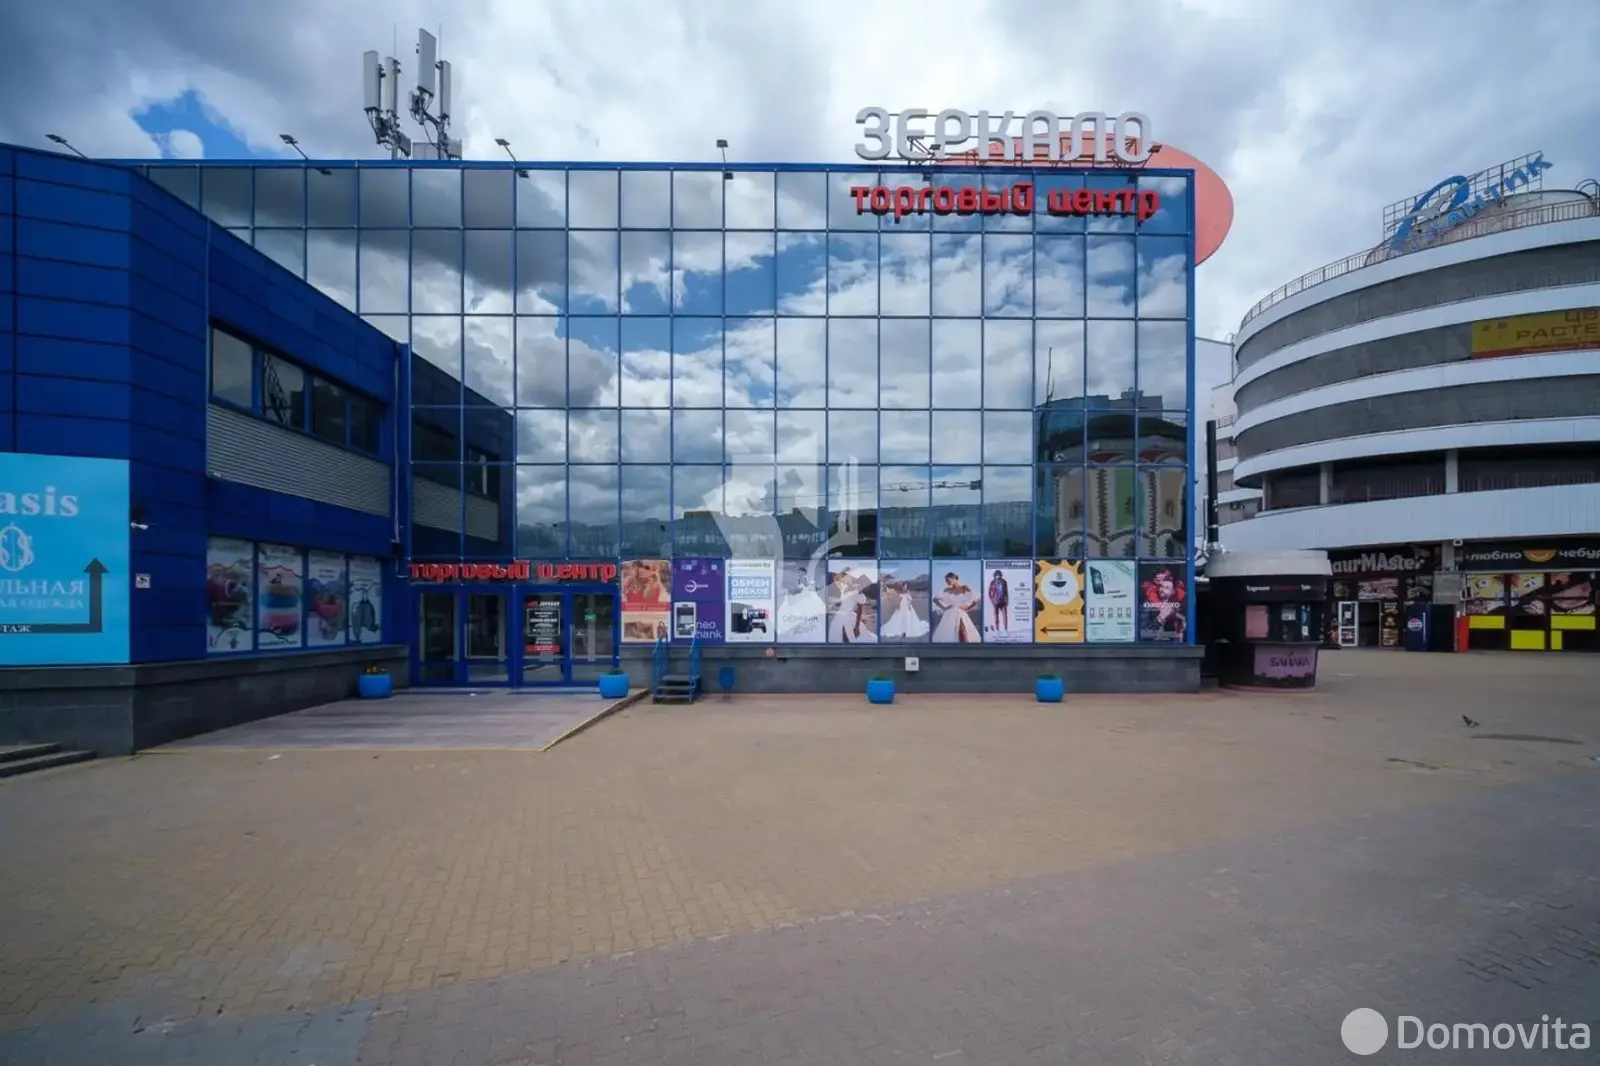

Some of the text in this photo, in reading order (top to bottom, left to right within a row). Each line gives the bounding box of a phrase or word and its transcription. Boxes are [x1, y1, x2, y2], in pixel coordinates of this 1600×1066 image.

[854, 106, 1153, 165] ЗЕРКАЛО
[850, 183, 1161, 226] торговый центр
[1470, 550, 1522, 561] люблю
[411, 560, 616, 583] торговый центр
[731, 578, 770, 588] ОБМЕН
[0, 625, 31, 633] ТАЖ
[696, 620, 716, 630] neo
